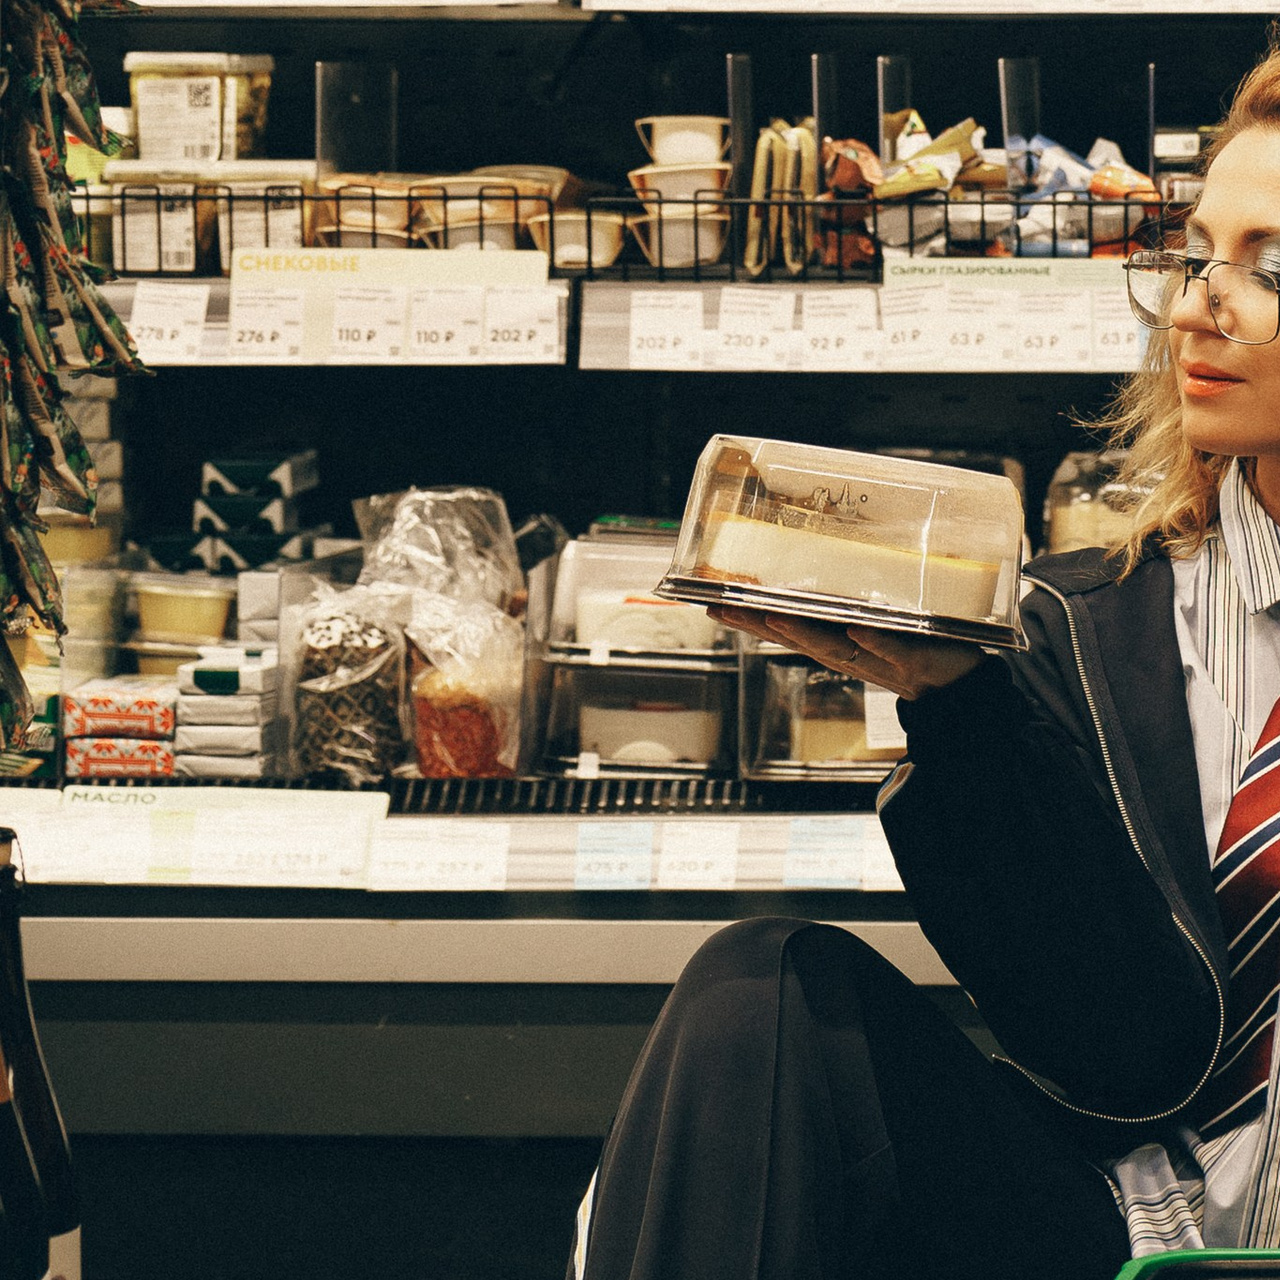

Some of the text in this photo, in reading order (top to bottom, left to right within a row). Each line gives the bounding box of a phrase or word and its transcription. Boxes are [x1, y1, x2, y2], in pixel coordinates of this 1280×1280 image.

[239, 255, 360, 272] СНЕКОВЫЕ
[236, 330, 264, 342] 276
[338, 329, 360, 341] 110
[416, 330, 437, 342] 110
[491, 329, 521, 342] 202
[71, 791, 157, 805] МАСЛО
